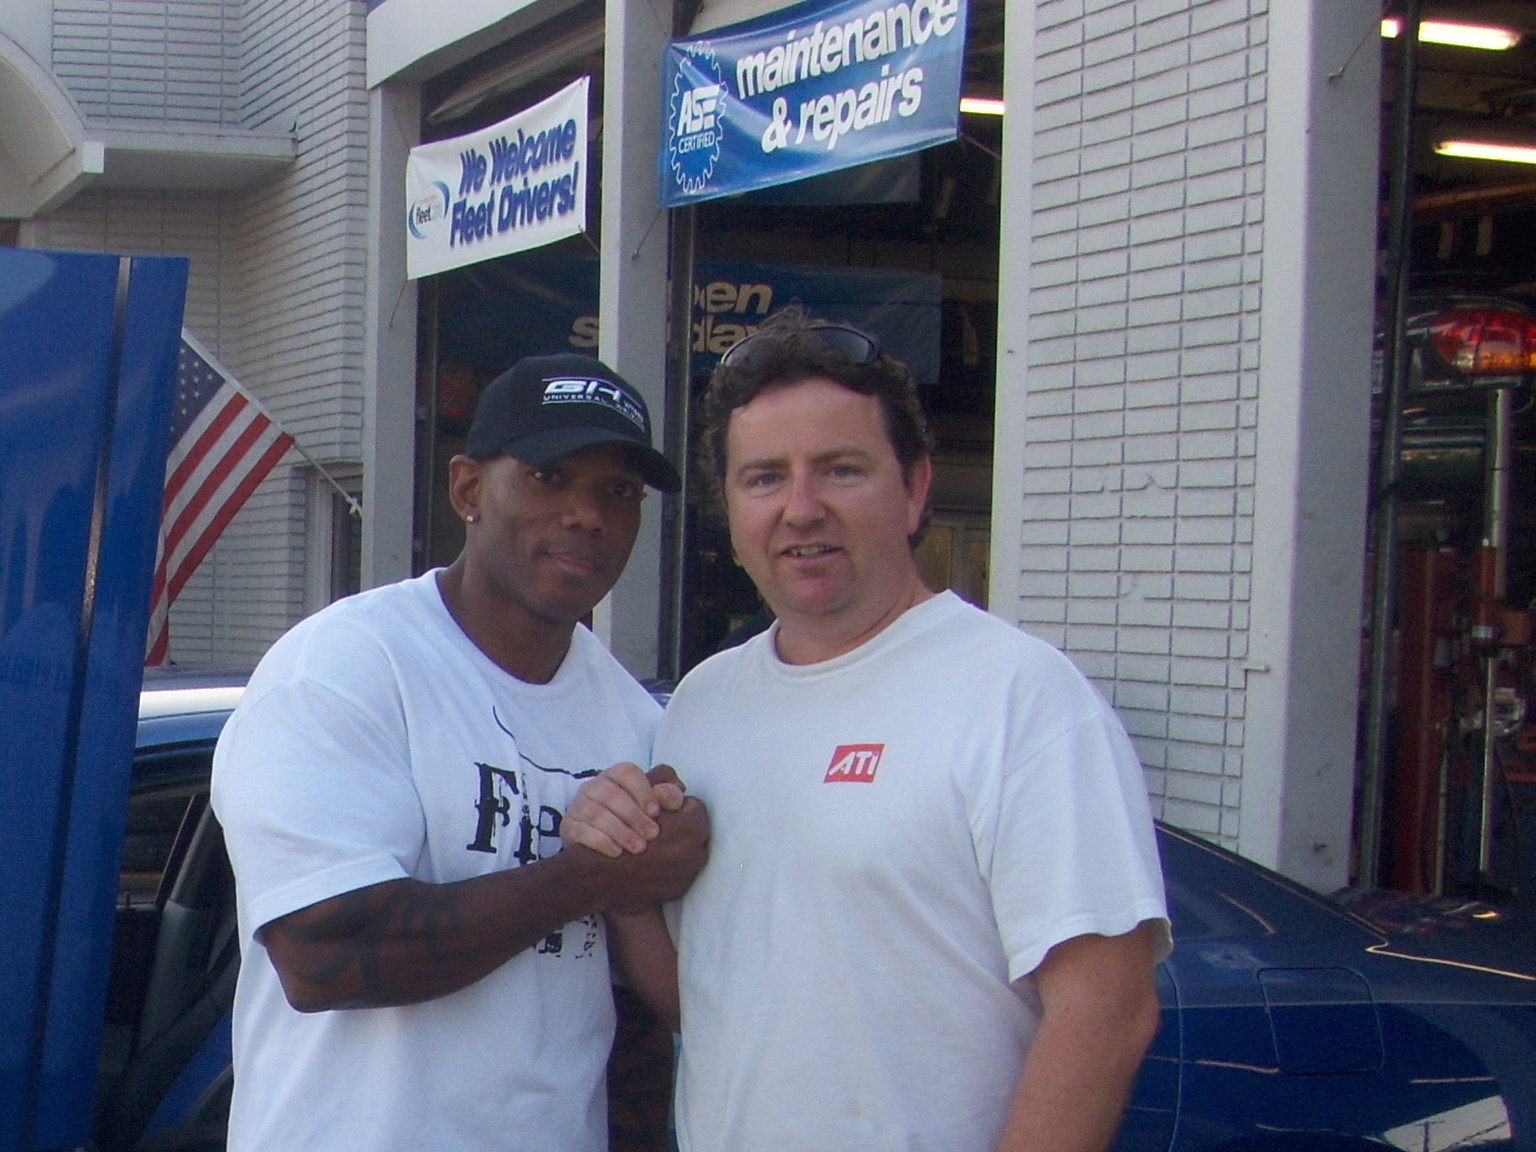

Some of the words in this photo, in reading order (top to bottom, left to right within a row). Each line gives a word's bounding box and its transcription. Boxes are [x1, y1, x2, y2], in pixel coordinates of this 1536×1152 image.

[736, 0, 958, 100] maintenance
[677, 84, 720, 136] ASE
[761, 97, 792, 152] &
[795, 64, 923, 150] repairs
[459, 148, 487, 198] We
[488, 119, 577, 186] Welcome
[678, 131, 715, 154] CERTIFIED
[450, 190, 495, 248] Fleet
[497, 161, 579, 233] Drivers!
[668, 281, 773, 314] en
[543, 394, 608, 404] UNIVERSAL
